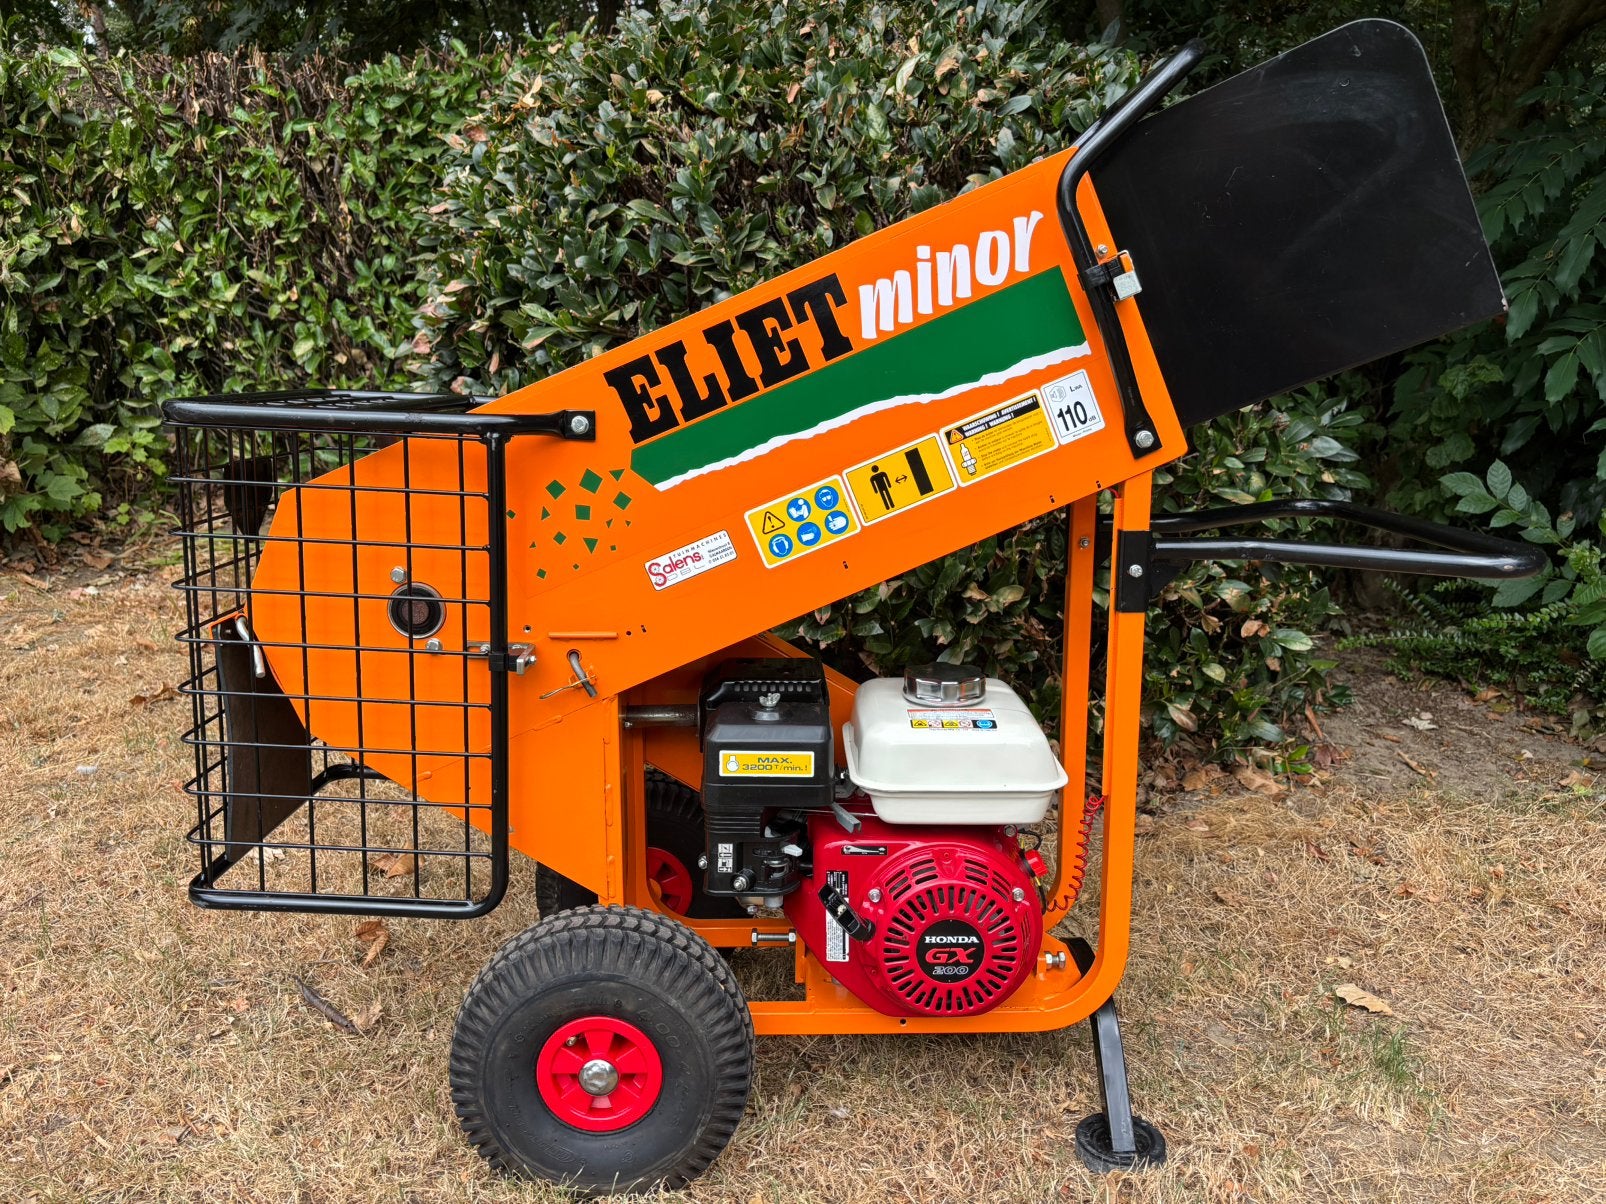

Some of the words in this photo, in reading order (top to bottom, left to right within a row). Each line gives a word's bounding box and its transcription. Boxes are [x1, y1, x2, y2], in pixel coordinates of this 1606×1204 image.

[603, 272, 853, 444] ELIET
[858, 210, 1044, 339] minor
[1057, 401, 1087, 431] 110
[647, 551, 702, 587] Salens
[742, 763, 773, 771] 3200
[925, 947, 977, 964] GX
[932, 965, 969, 975] 200
